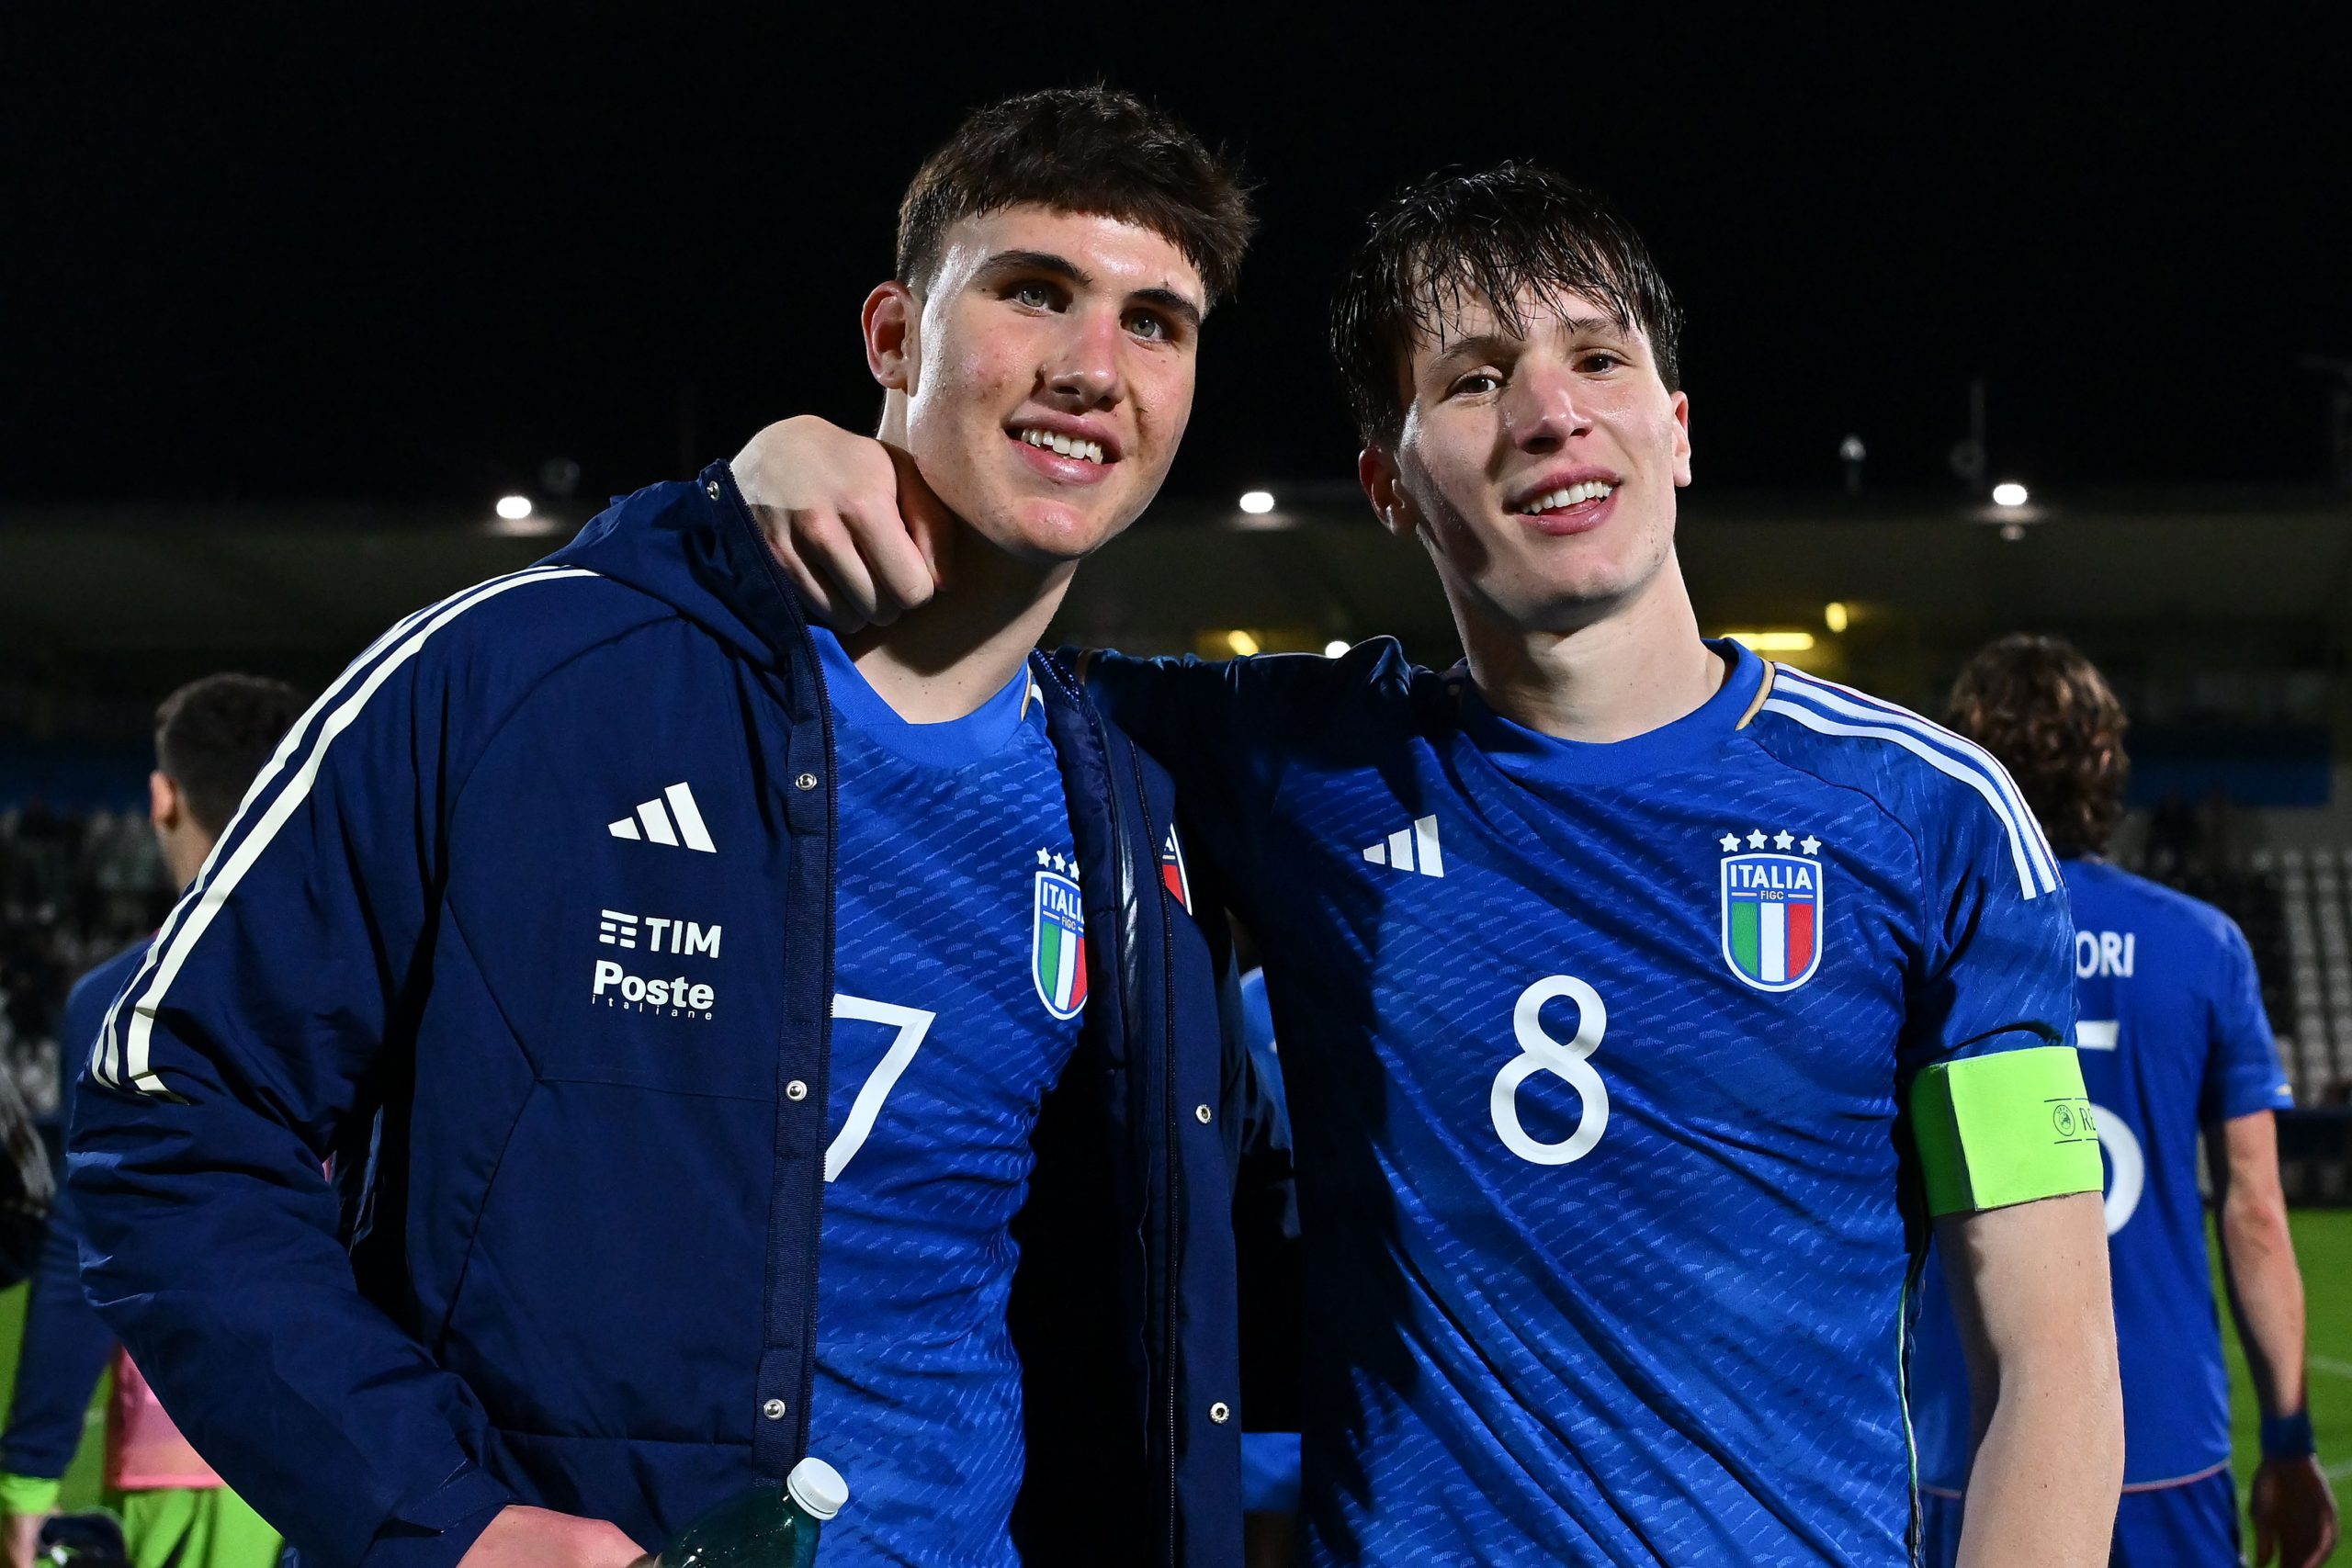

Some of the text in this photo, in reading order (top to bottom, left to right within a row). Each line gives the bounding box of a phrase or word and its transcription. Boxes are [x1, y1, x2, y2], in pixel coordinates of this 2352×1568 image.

[1731, 864, 1813, 890] ITALIA
[1760, 890, 1784, 900] FIGC
[1043, 882, 1085, 924] ITALI
[1061, 916, 1077, 931] FIGC
[645, 917, 722, 959] TIM
[593, 959, 715, 1010] Poste
[592, 994, 712, 1021] italiane
[823, 993, 936, 1183] 7
[1490, 975, 1610, 1166] 8
